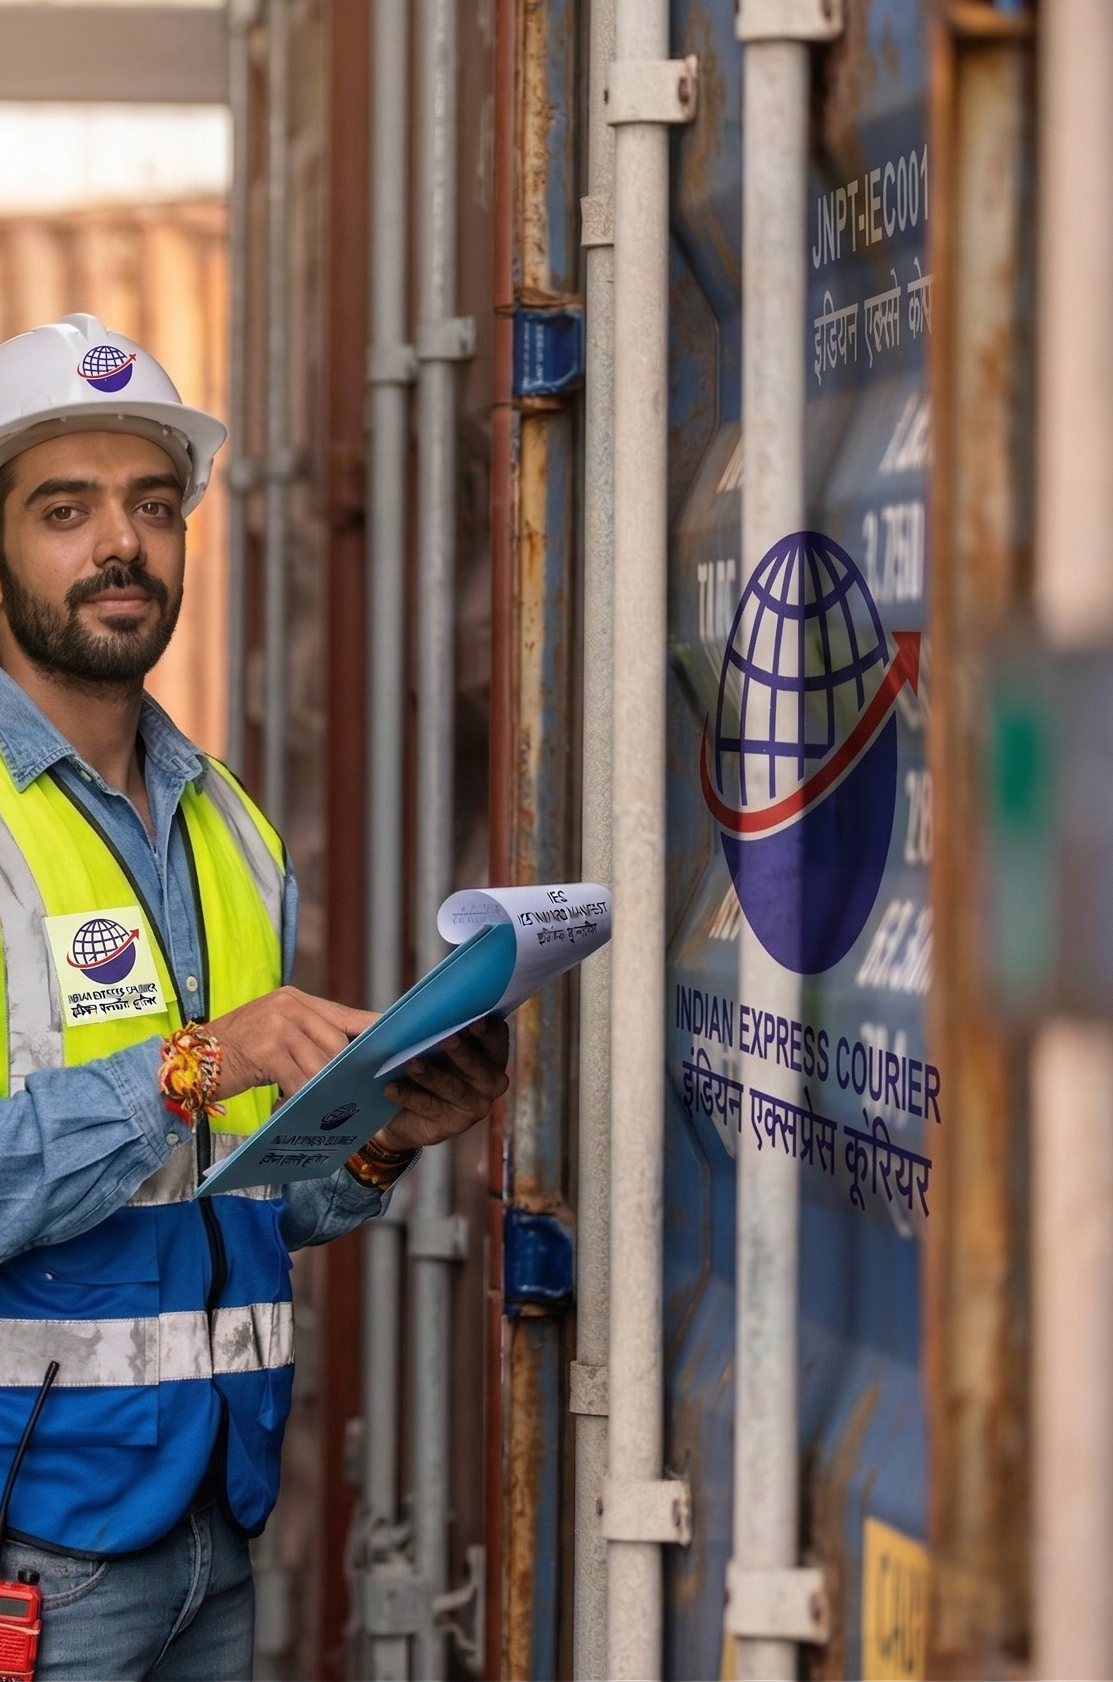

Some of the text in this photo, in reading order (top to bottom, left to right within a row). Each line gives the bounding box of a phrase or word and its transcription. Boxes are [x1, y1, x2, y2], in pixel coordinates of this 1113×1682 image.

[812, 144, 929, 269] JNPT-IEC001
[676, 984, 733, 1047] INDIAN
[740, 1004, 829, 1082] EXPRESS
[837, 1037, 941, 1124] COURIER
[682, 1047, 744, 1133] इंडियन
[749, 1086, 837, 1176] एक्सप्रेस
